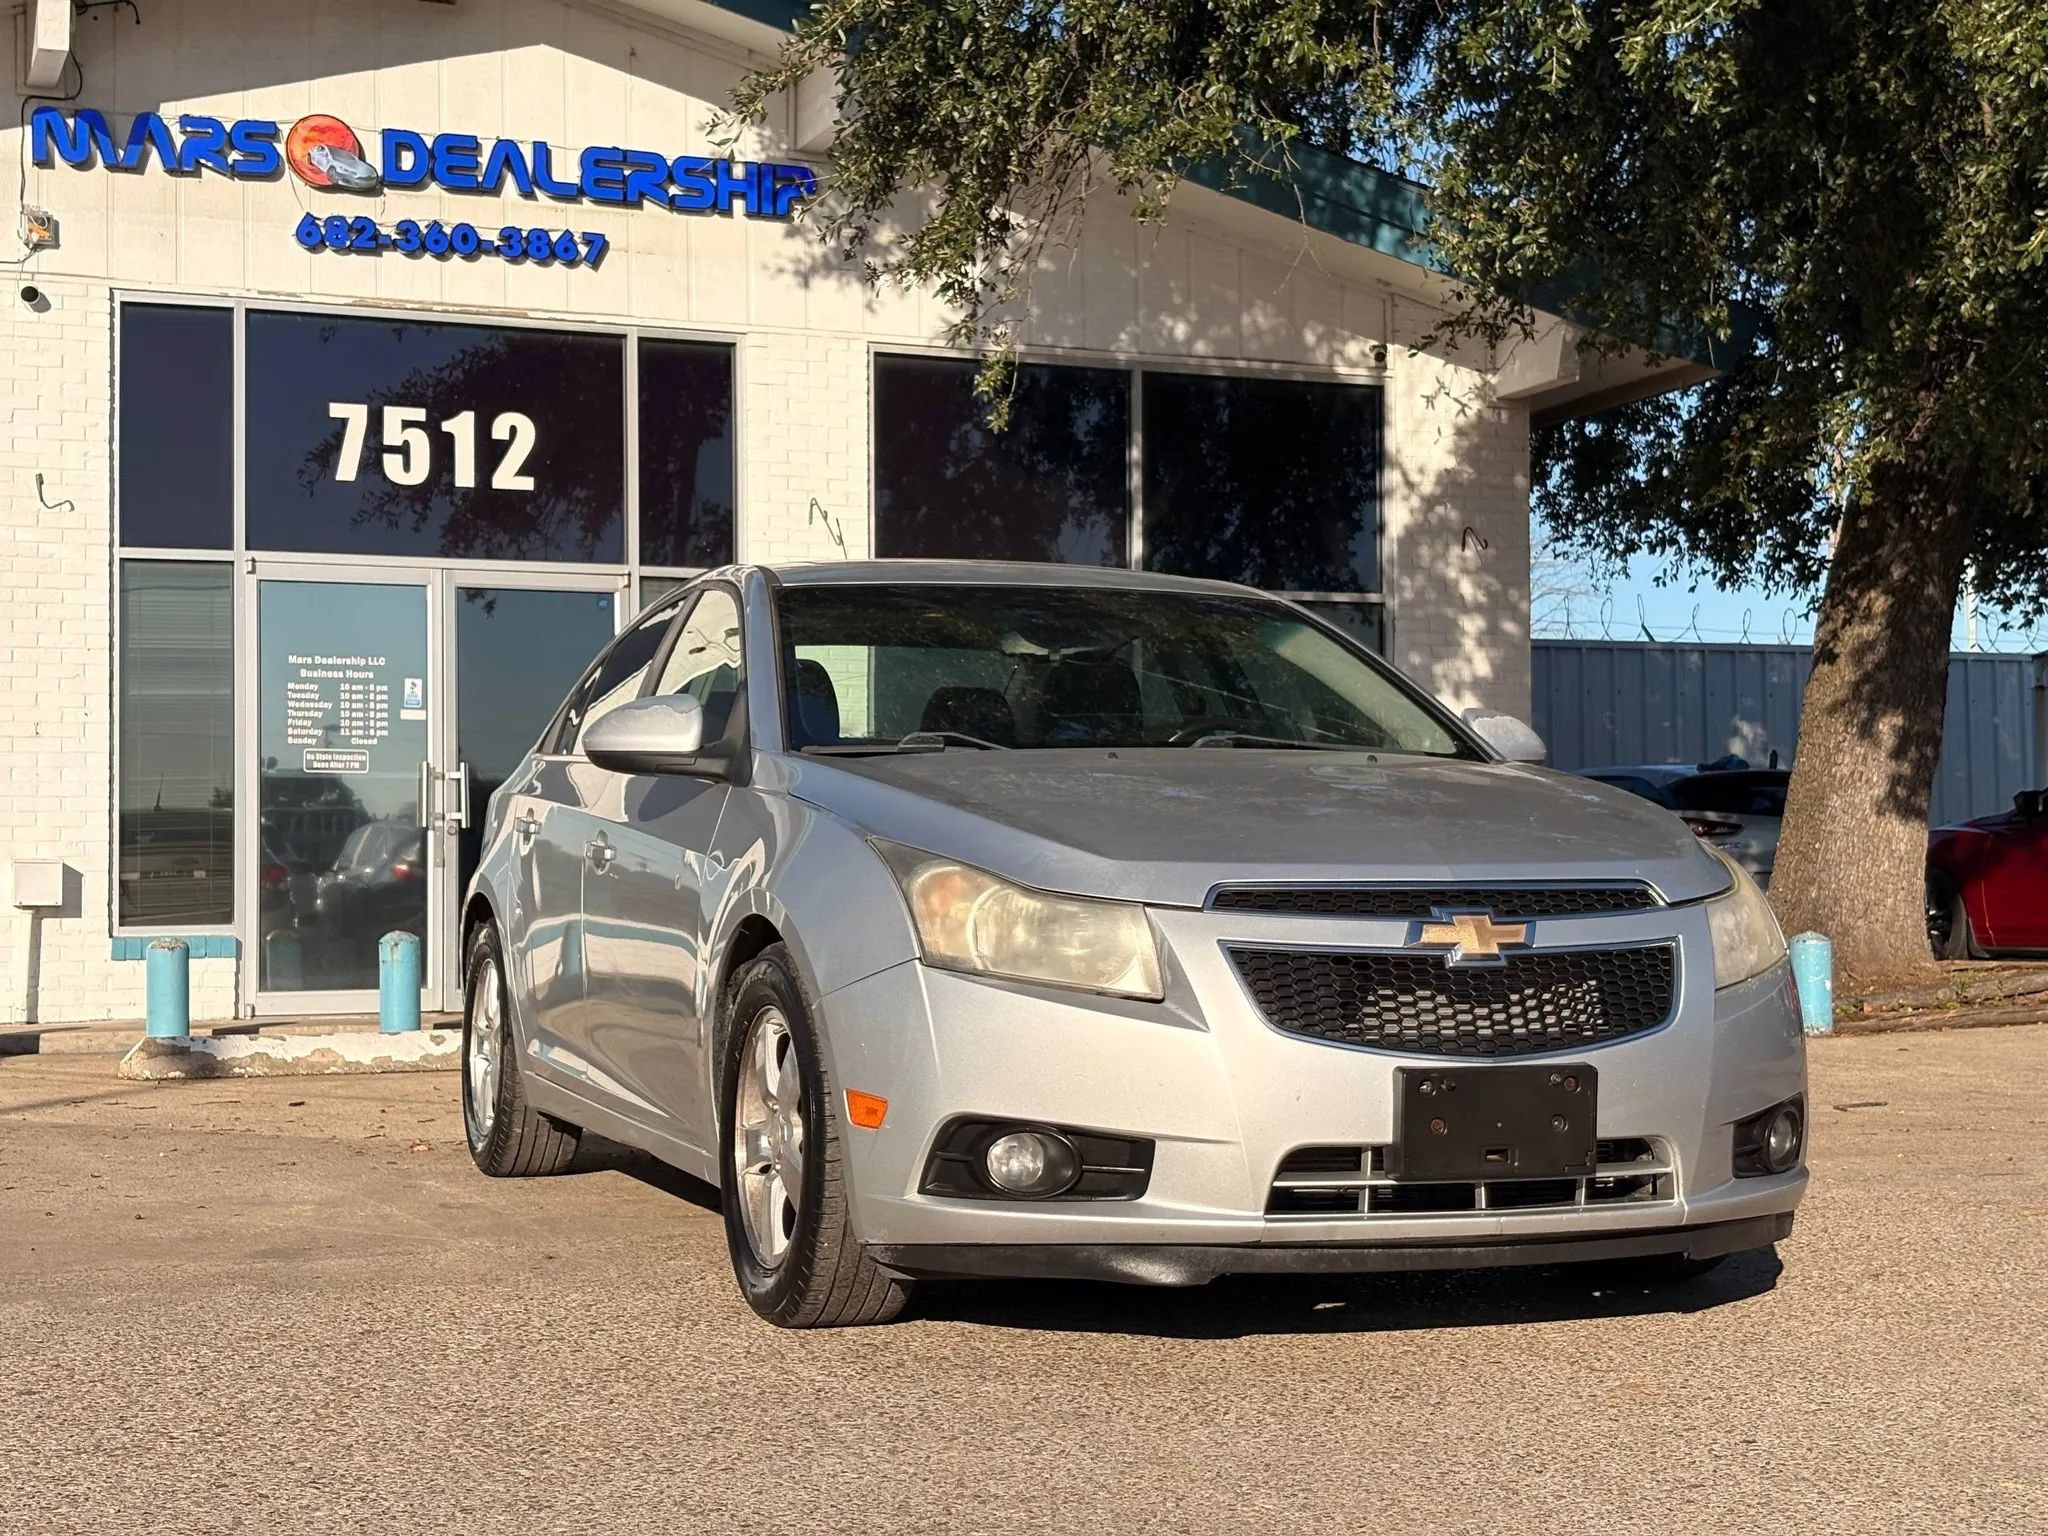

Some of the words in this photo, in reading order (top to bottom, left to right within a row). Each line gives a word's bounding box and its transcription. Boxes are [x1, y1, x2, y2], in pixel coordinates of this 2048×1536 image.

[31, 105, 281, 179] MARS
[382, 128, 818, 218] DEALERSHIP
[296, 212, 608, 266] 682-360-3867
[329, 402, 536, 491] 7512
[288, 655, 312, 664] Mars
[315, 656, 366, 666] Dealership
[368, 657, 385, 665] LLC
[300, 669, 343, 677] Business
[346, 670, 373, 678] Hours
[288, 683, 318, 691] Monday
[288, 692, 319, 700] Tuesday
[288, 701, 332, 709] Wednesday
[288, 710, 323, 718] Thursday
[288, 719, 312, 727] Friday
[288, 728, 322, 736] Saturday
[288, 737, 316, 745] Sunday
